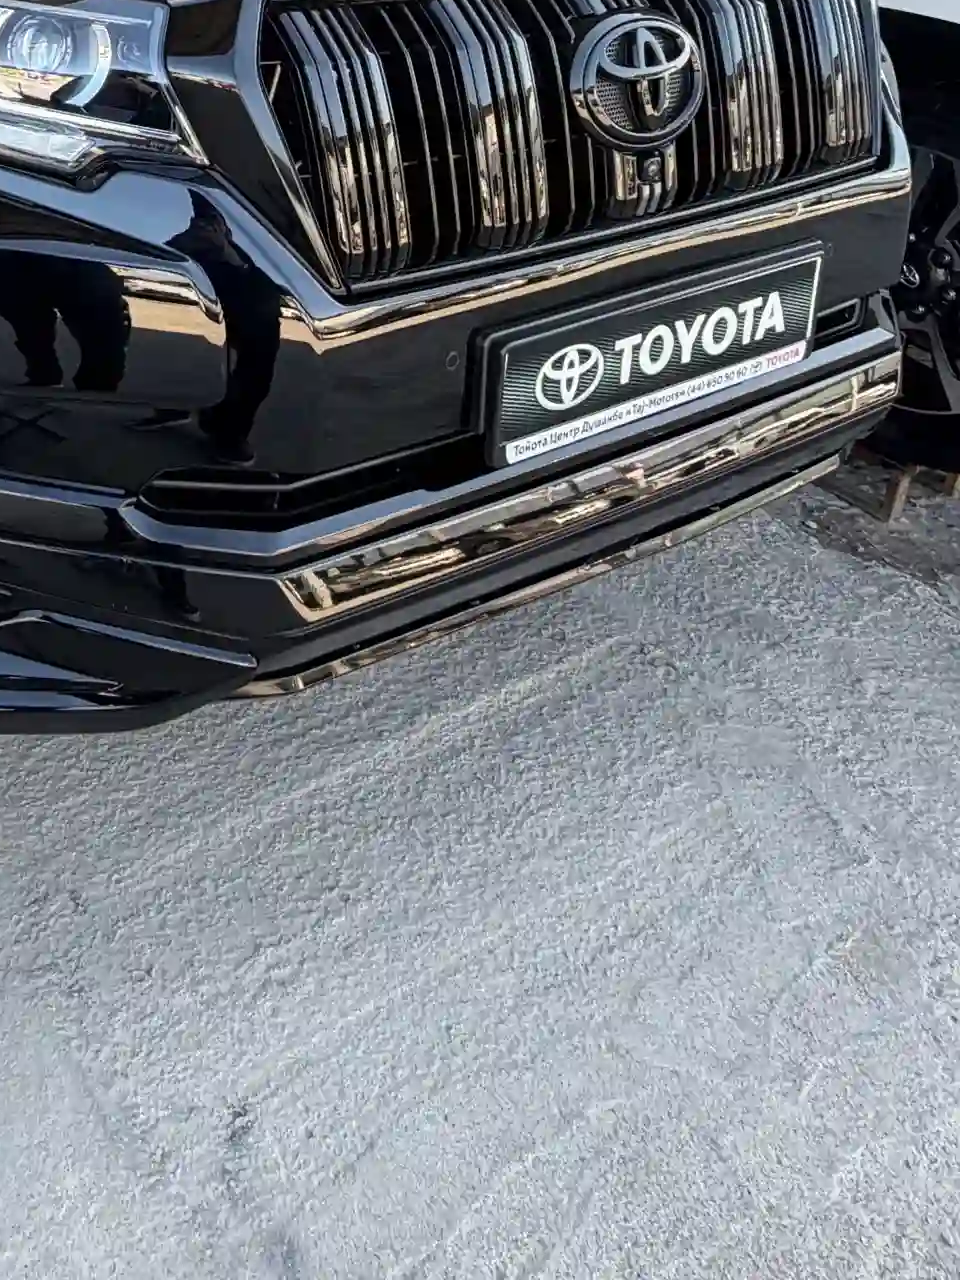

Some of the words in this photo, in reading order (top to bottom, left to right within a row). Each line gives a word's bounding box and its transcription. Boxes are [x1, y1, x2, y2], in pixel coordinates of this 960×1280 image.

[614, 291, 786, 385] TOYOTA
[766, 347, 801, 369] TOYOTA
[514, 438, 548, 456] Тойота
[549, 424, 580, 442] Центр
